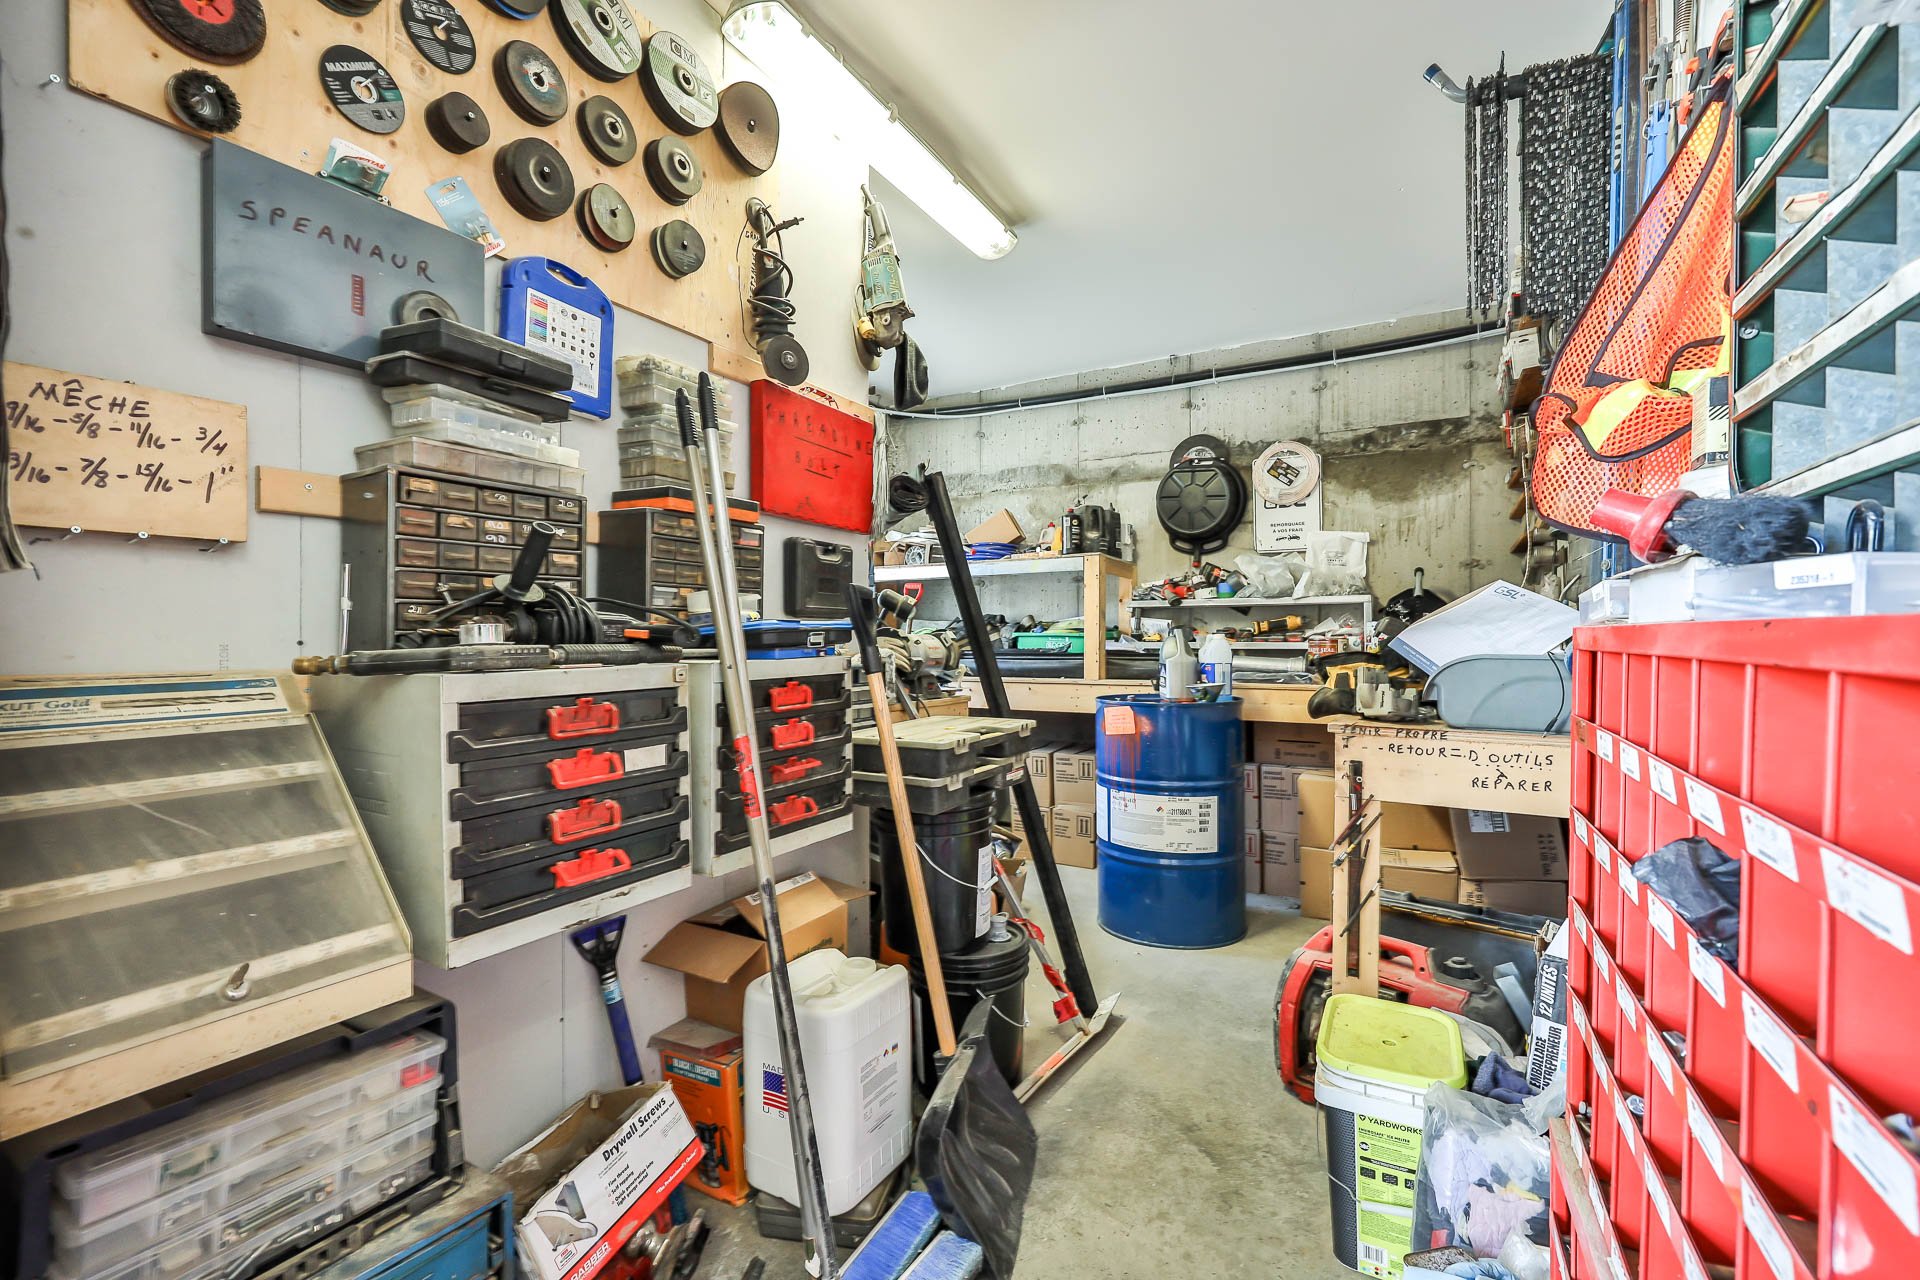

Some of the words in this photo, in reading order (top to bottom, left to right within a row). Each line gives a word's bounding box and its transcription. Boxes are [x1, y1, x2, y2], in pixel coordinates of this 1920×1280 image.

[325, 61, 378, 72] MAXIMUM
[238, 200, 435, 284] SPEANAUR
[28, 378, 151, 418] MÊCHE
[6, 400, 45, 433] 9/16
[69, 412, 101, 439] 5/8
[130, 421, 166, 450] 11/16
[195, 426, 228, 457] 3/4
[80, 456, 109, 489] 7/8
[135, 461, 173, 492] 15/16
[43, 699, 90, 709] Gold
[1395, 730, 1449, 741] PROPRE
[1471, 777, 1553, 792] RÉPARER
[1538, 964, 1559, 1004] UNITÉS
[1538, 1002, 1553, 1018] 12
[762, 1062, 785, 1075] MAD
[1529, 1035, 1547, 1090] EMBALLAGE
[602, 1121, 638, 1162] Drywall
[637, 1097, 666, 1128] Screws
[1367, 1116, 1423, 1136] YARDWORKS
